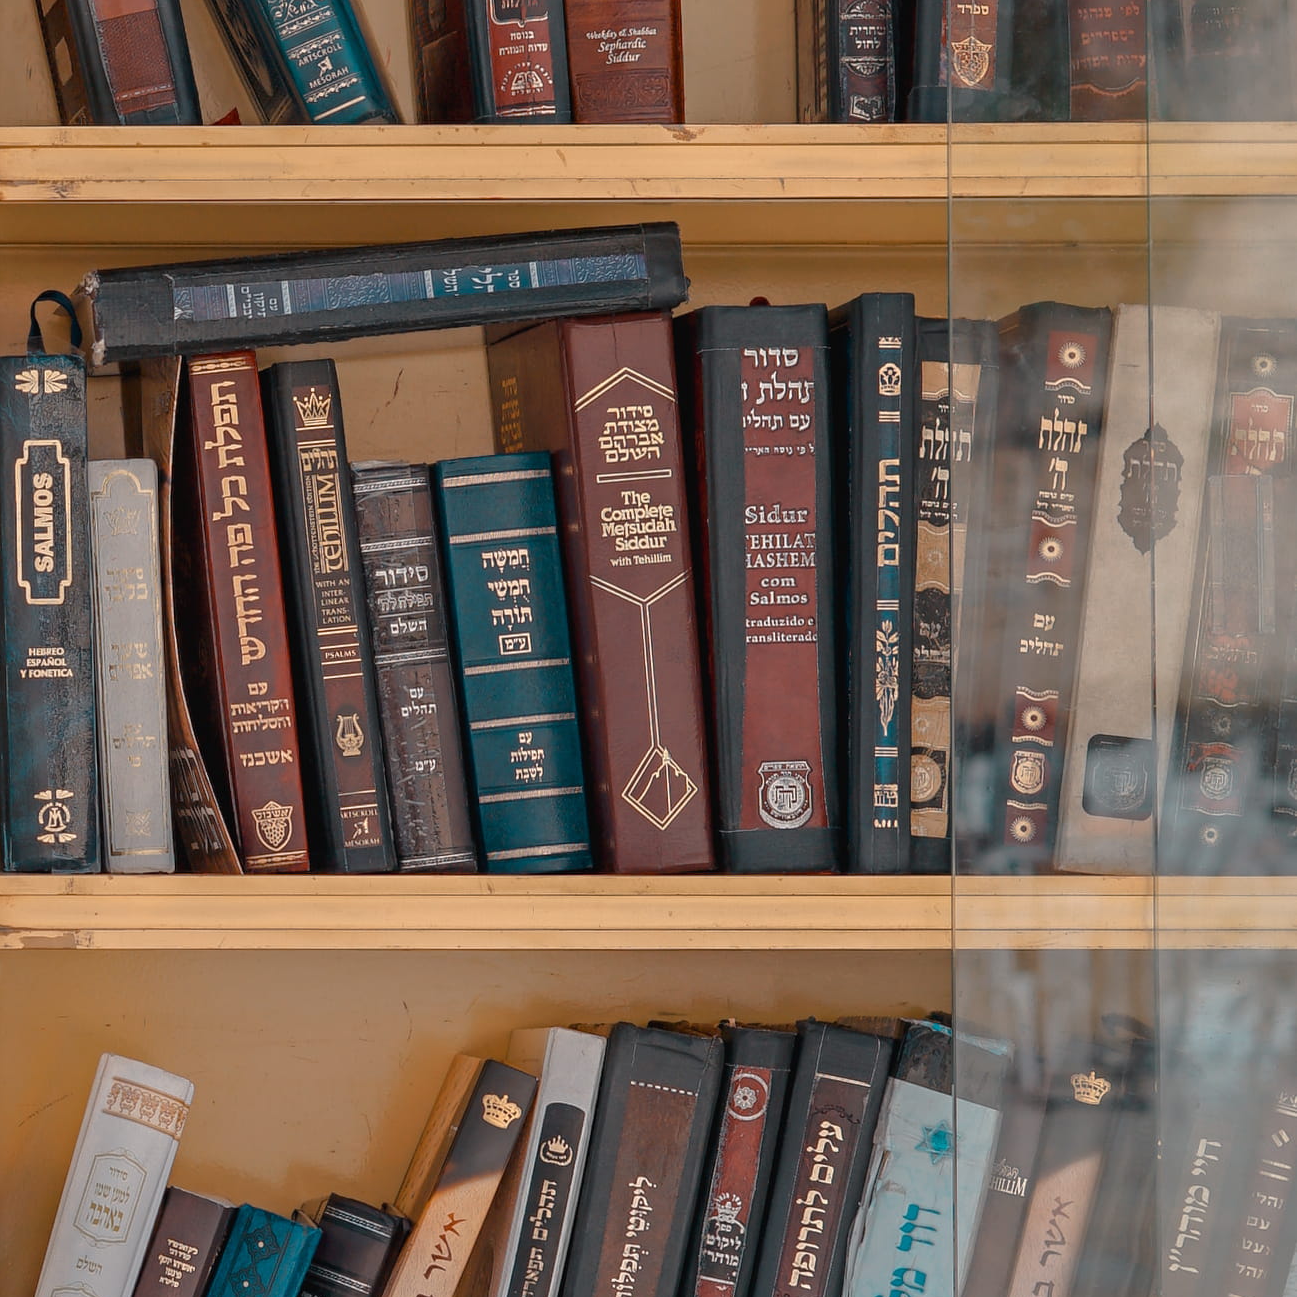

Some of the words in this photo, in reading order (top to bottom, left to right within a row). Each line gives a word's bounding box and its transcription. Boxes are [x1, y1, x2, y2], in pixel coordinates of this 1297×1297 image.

[957, 4, 989, 15] ספרד
[586, 29, 618, 40] Weekday
[598, 39, 647, 53] Sephardic
[855, 38, 880, 49] לחול
[297, 42, 343, 67] ARTSCROLL
[606, 52, 640, 63] Siddur
[308, 65, 351, 89] MESORAH
[744, 348, 799, 368] סדור
[607, 406, 653, 420] סידור
[204, 381, 241, 469] תפלת
[604, 418, 660, 434] מצודת
[790, 414, 810, 431] עם
[599, 432, 665, 451] אברהם
[606, 445, 660, 463] השלם
[213, 476, 250, 522] כל
[621, 491, 651, 507] The
[600, 505, 674, 523] Complete
[745, 505, 808, 524] Sidur
[878, 457, 901, 568] תהלים
[34, 472, 54, 572] SALMOS
[602, 518, 677, 538] Metsudah
[227, 522, 253, 568] פה
[614, 533, 667, 551] Siddur
[610, 554, 631, 568] with
[633, 552, 672, 566] Tehillim
[316, 579, 336, 588] WITH
[376, 565, 428, 587] סידור
[761, 576, 796, 588] com
[321, 589, 346, 597] INTER-
[321, 597, 349, 606] LINEAR
[750, 591, 808, 605] Salmos
[234, 573, 267, 666] החדש
[322, 615, 351, 624] LATION
[390, 617, 427, 634] השלם
[746, 616, 805, 628] traduzido
[28, 647, 65, 656] HEBREO
[324, 649, 358, 660] PSALMS
[27, 657, 67, 668] ESPAÑOL
[20, 669, 27, 677] Y
[28, 668, 73, 678] FONETICA
[248, 681, 268, 695] עם
[409, 687, 424, 698] עם
[230, 698, 291, 716] הקריאות
[401, 703, 437, 717] תהלים
[232, 714, 292, 733] והסליחות
[239, 746, 294, 767] אשכנז
[530, 1179, 557, 1241] תהלים
[896, 1203, 941, 1254] דוד
[1039, 1195, 1075, 1270] אשר
[425, 1211, 467, 1287] אשר
[788, 1190, 829, 1291] לתרופה
[76, 1255, 103, 1275] השלם
